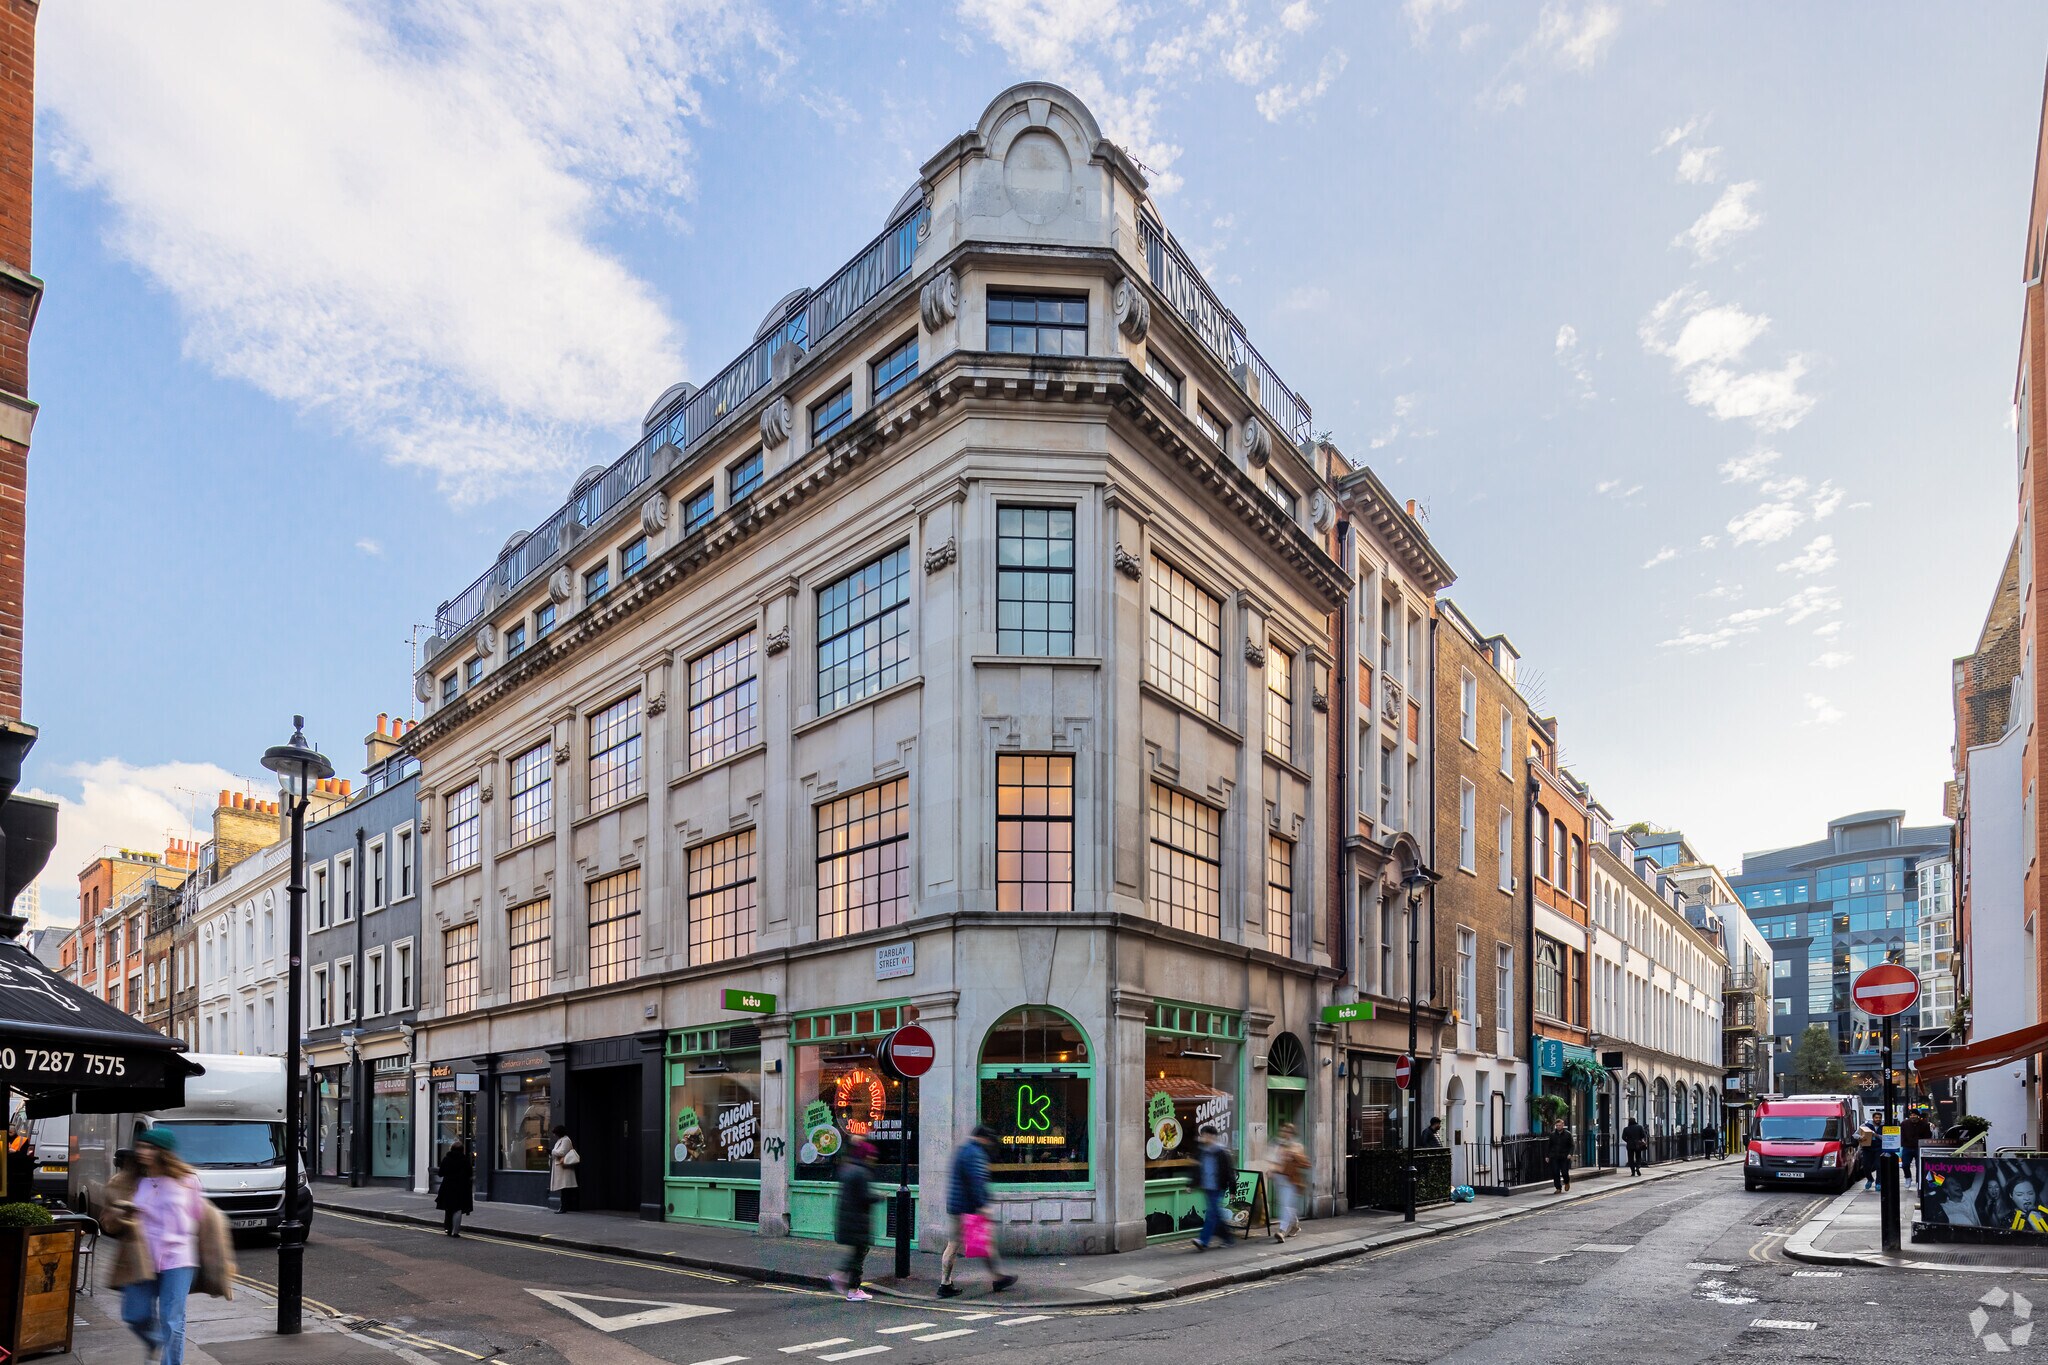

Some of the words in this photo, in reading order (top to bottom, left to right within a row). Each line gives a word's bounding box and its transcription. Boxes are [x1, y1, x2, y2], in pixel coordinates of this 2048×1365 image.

[879, 946, 906, 959] D'ARBLAY
[879, 957, 899, 969] STREET
[901, 956, 909, 965] W1
[742, 994, 760, 1007] kêu
[1339, 1007, 1357, 1018] kêu
[25, 1050, 74, 1072] 7287
[83, 1054, 125, 1076] 7575
[868, 1081, 882, 1120] BOWLS
[1154, 1097, 1166, 1109] RICE
[718, 1100, 753, 1130] SAIGON
[1152, 1105, 1170, 1119] BOWLS
[1195, 1093, 1228, 1123] SAIGON
[720, 1117, 757, 1147] STREET
[845, 1119, 866, 1134] BUNS
[1003, 1135, 1015, 1145] EAT
[1015, 1135, 1035, 1144] DRINK
[1036, 1136, 1065, 1145] VIETNAM
[727, 1138, 754, 1162] FOOD
[1925, 1162, 1953, 1173] lucky
[1955, 1163, 1985, 1173] voice
